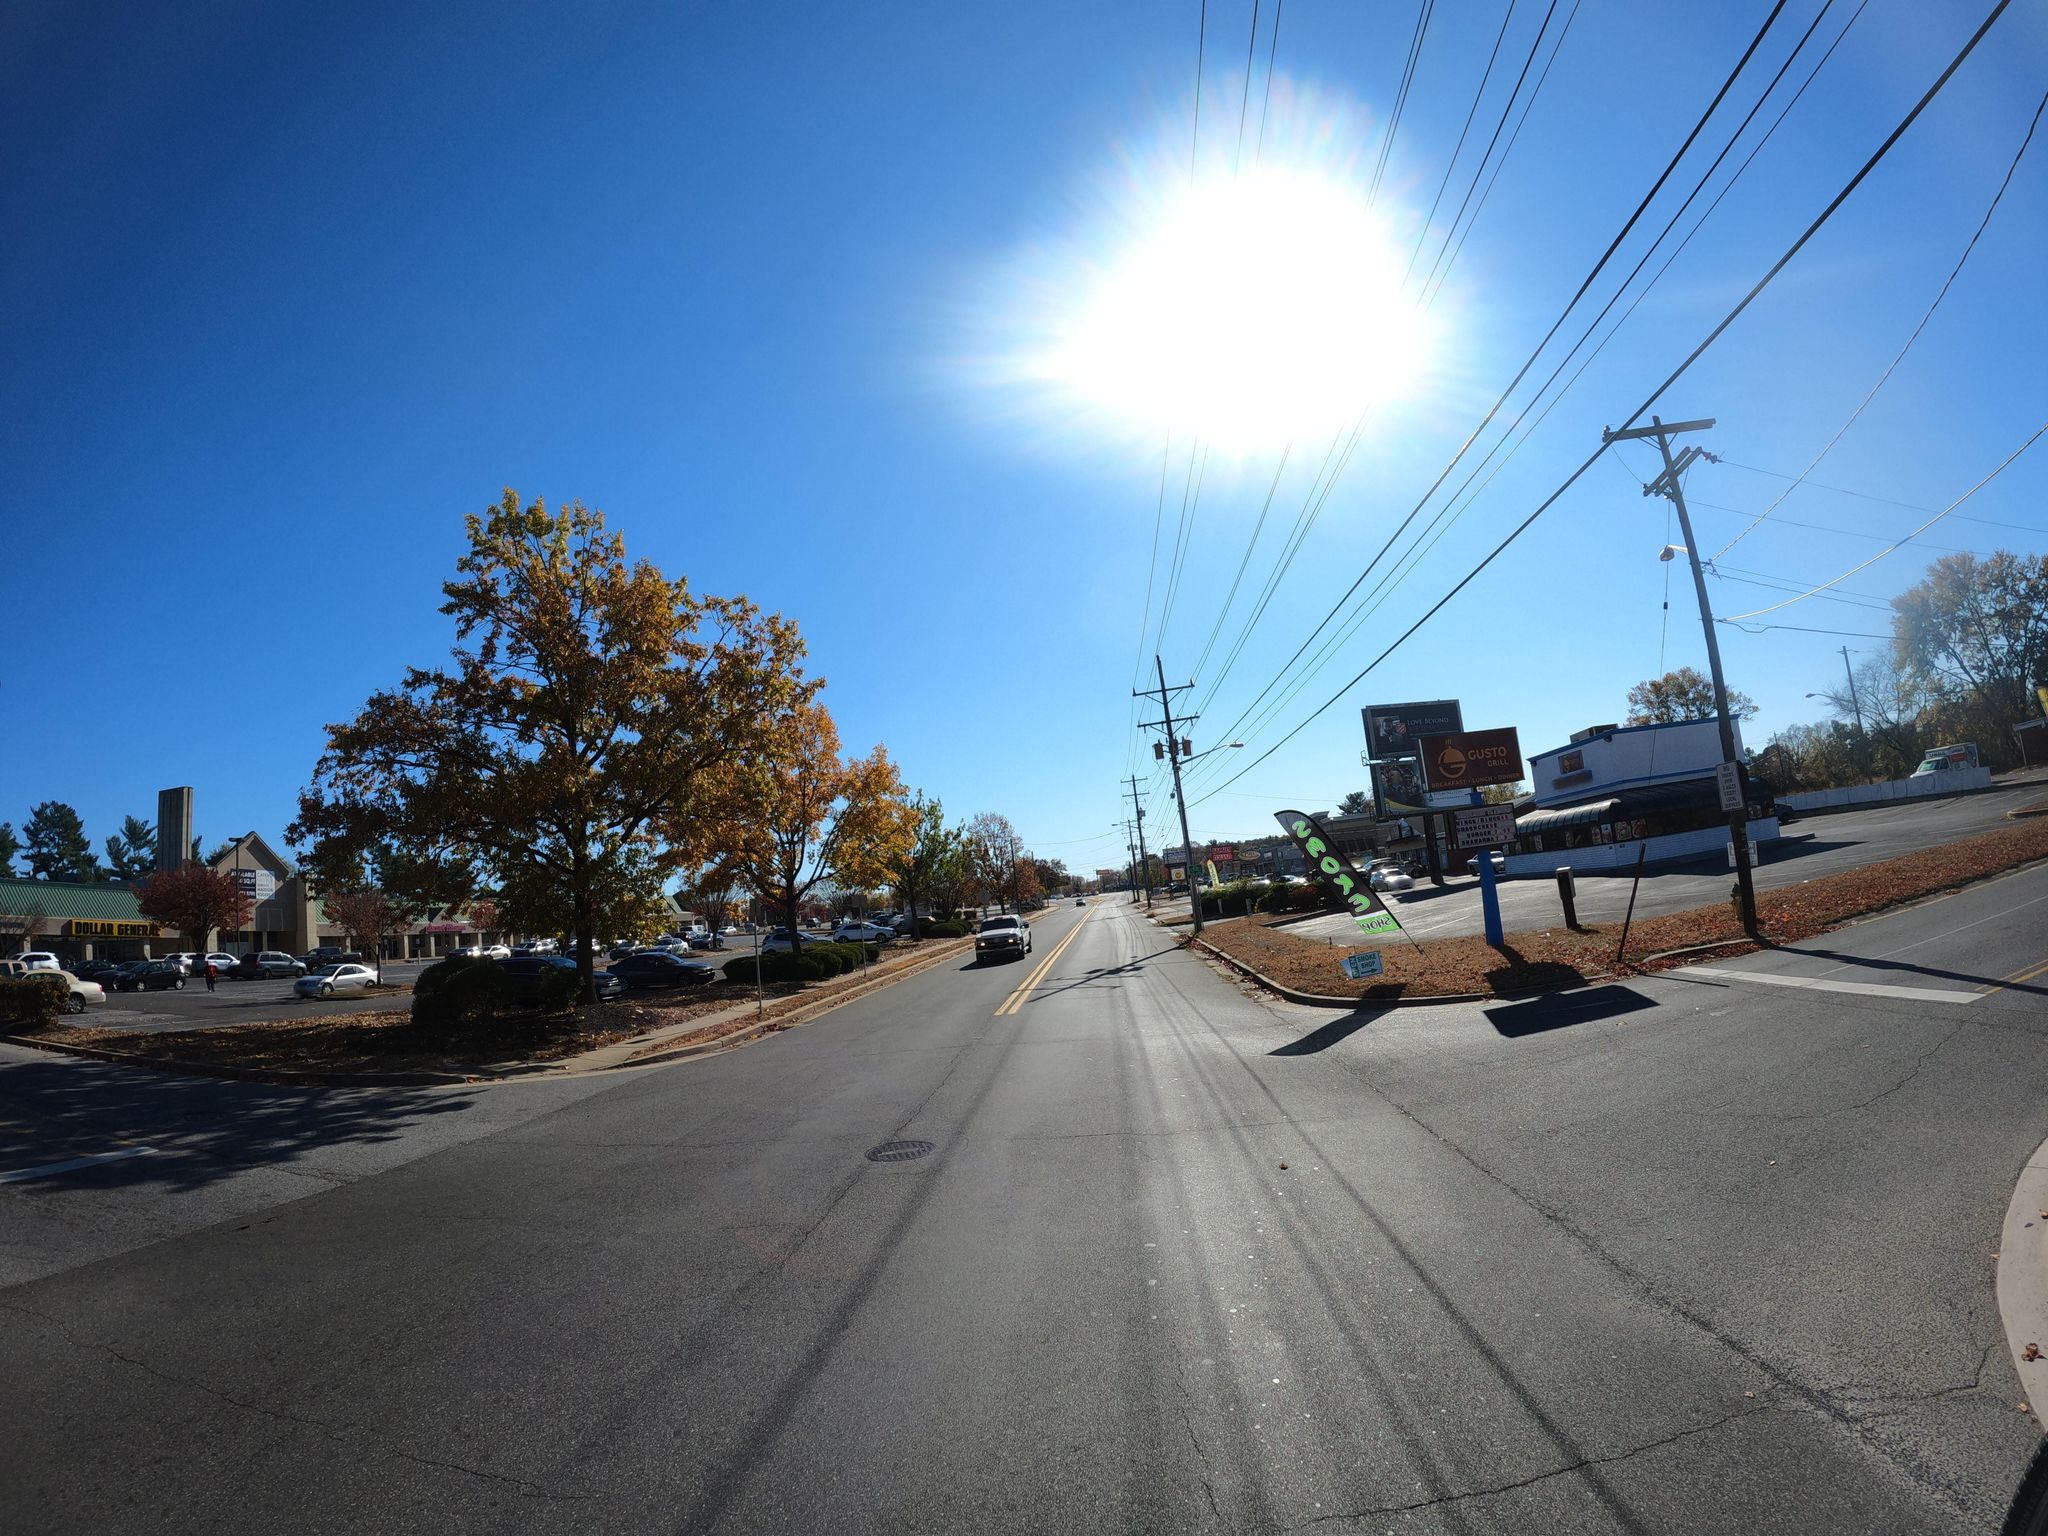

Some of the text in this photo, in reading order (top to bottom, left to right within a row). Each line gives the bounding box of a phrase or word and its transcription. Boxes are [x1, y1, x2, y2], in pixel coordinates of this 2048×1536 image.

[1468, 747, 1507, 760] GUSTO
[1488, 759, 1509, 767] GRILL
[1431, 780, 1466, 788] BREAKFAST
[75, 921, 161, 937] DOLLAR GENERAL
[1357, 953, 1377, 963] SMOKE
[1360, 960, 1377, 969] SHOP
